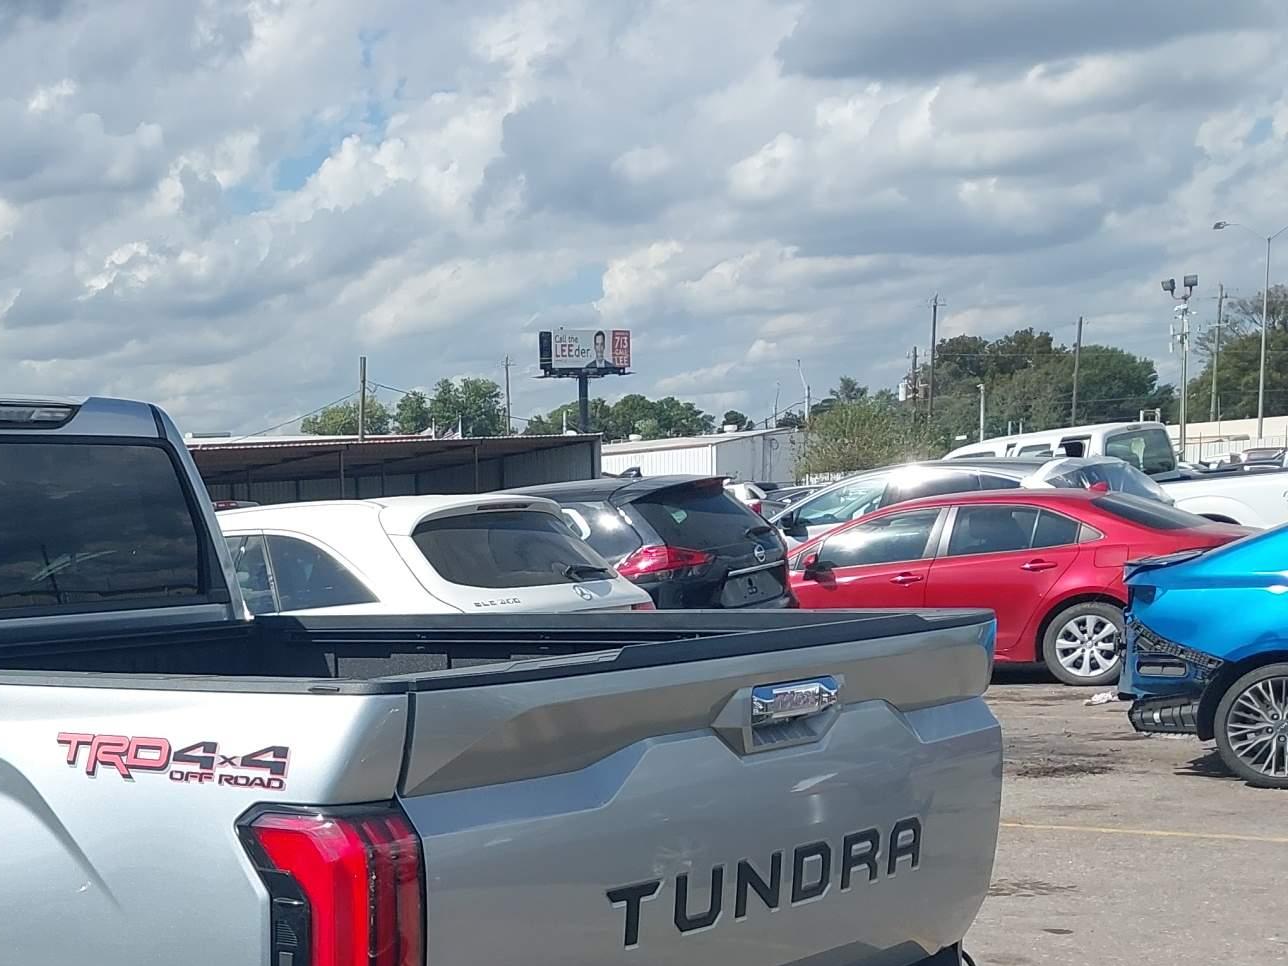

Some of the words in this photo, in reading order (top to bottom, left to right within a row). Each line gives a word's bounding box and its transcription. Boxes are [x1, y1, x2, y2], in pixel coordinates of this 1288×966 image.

[554, 335, 567, 344] Call
[615, 356, 629, 366] LEE
[56, 731, 173, 783] TRD
[168, 769, 215, 784] OFF
[217, 775, 287, 792] ROAD
[606, 815, 923, 950] TUNDRA
